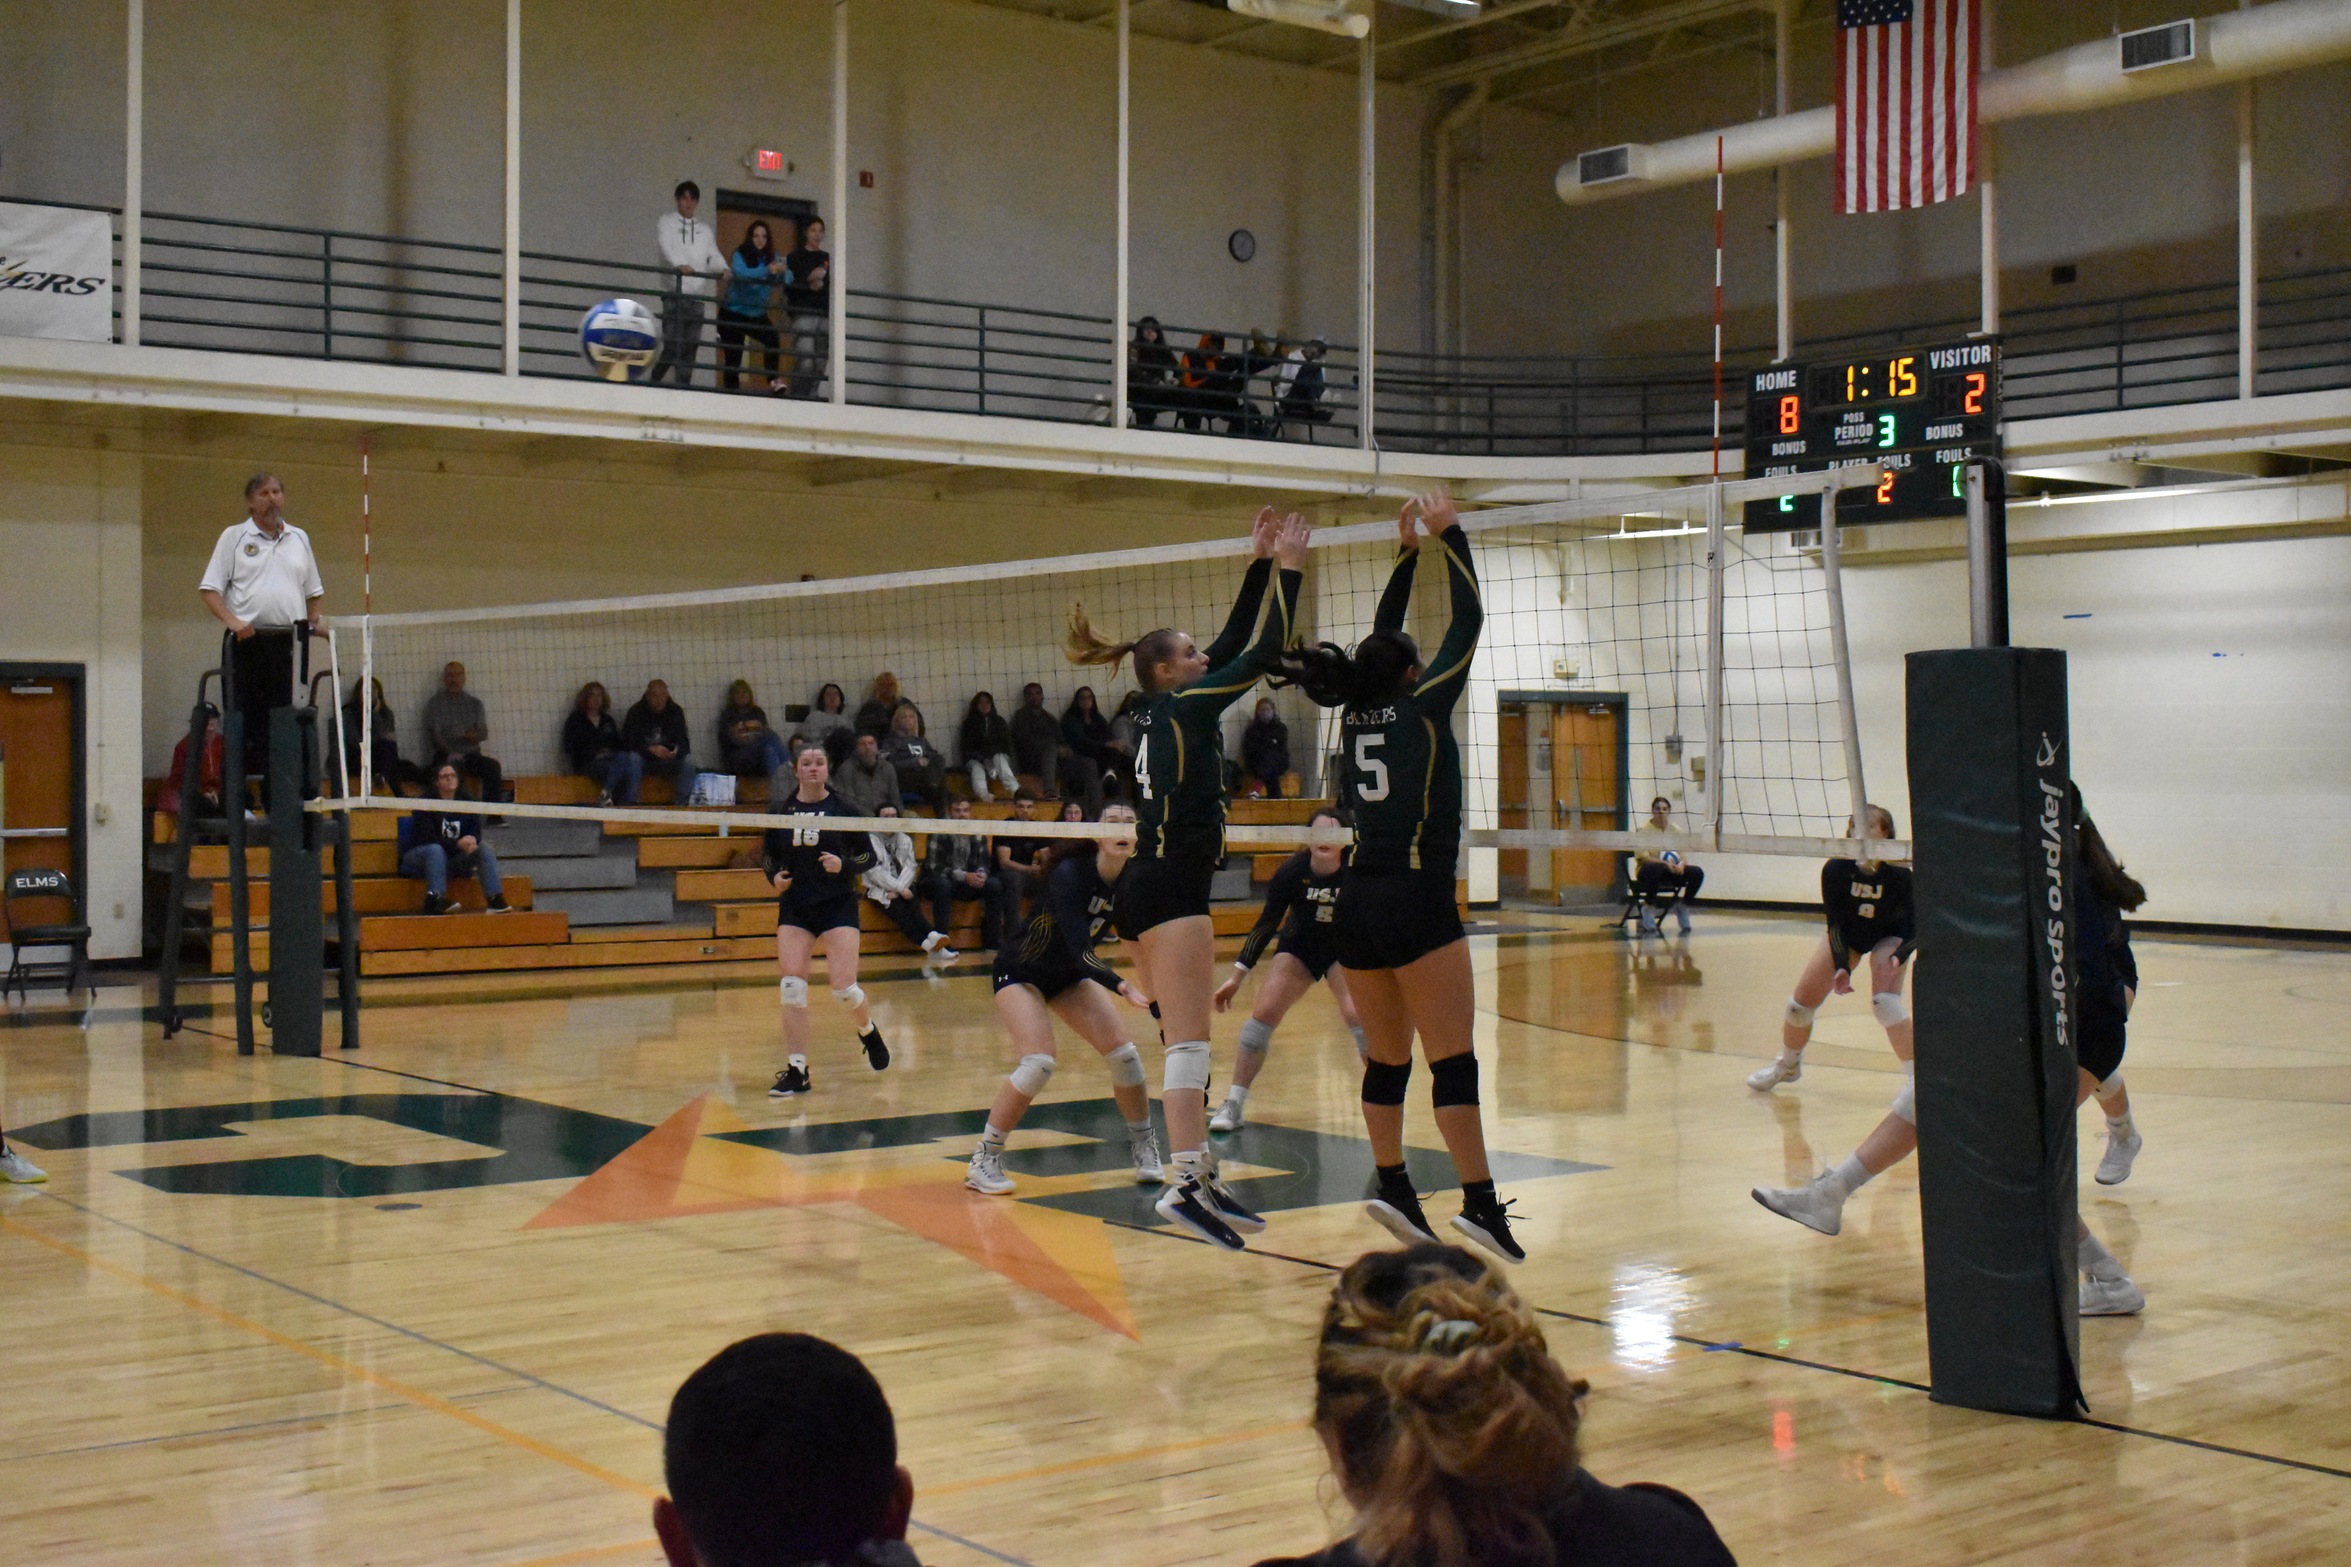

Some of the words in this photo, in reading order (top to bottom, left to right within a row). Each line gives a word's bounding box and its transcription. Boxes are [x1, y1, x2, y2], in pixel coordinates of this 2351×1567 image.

[759, 150, 782, 171] EXIT
[1930, 344, 1992, 369] VISITOR
[1755, 370, 1797, 392] HOME
[1846, 356, 1917, 402] 1:15
[1964, 372, 1985, 415] 2
[1780, 395, 1799, 434] 8
[1843, 412, 1863, 424] POSS
[1834, 423, 1874, 440] PERIOD
[1878, 414, 1896, 447] 3
[1925, 423, 1963, 440] BONUS
[1771, 440, 1807, 456] BONUS
[1935, 447, 1972, 463] FOULS
[1876, 471, 1894, 503] 2
[1134, 733, 1154, 800] 4
[1355, 733, 1390, 802] 5
[15, 876, 59, 889] ELMS
[2046, 918, 2071, 1046] sports
